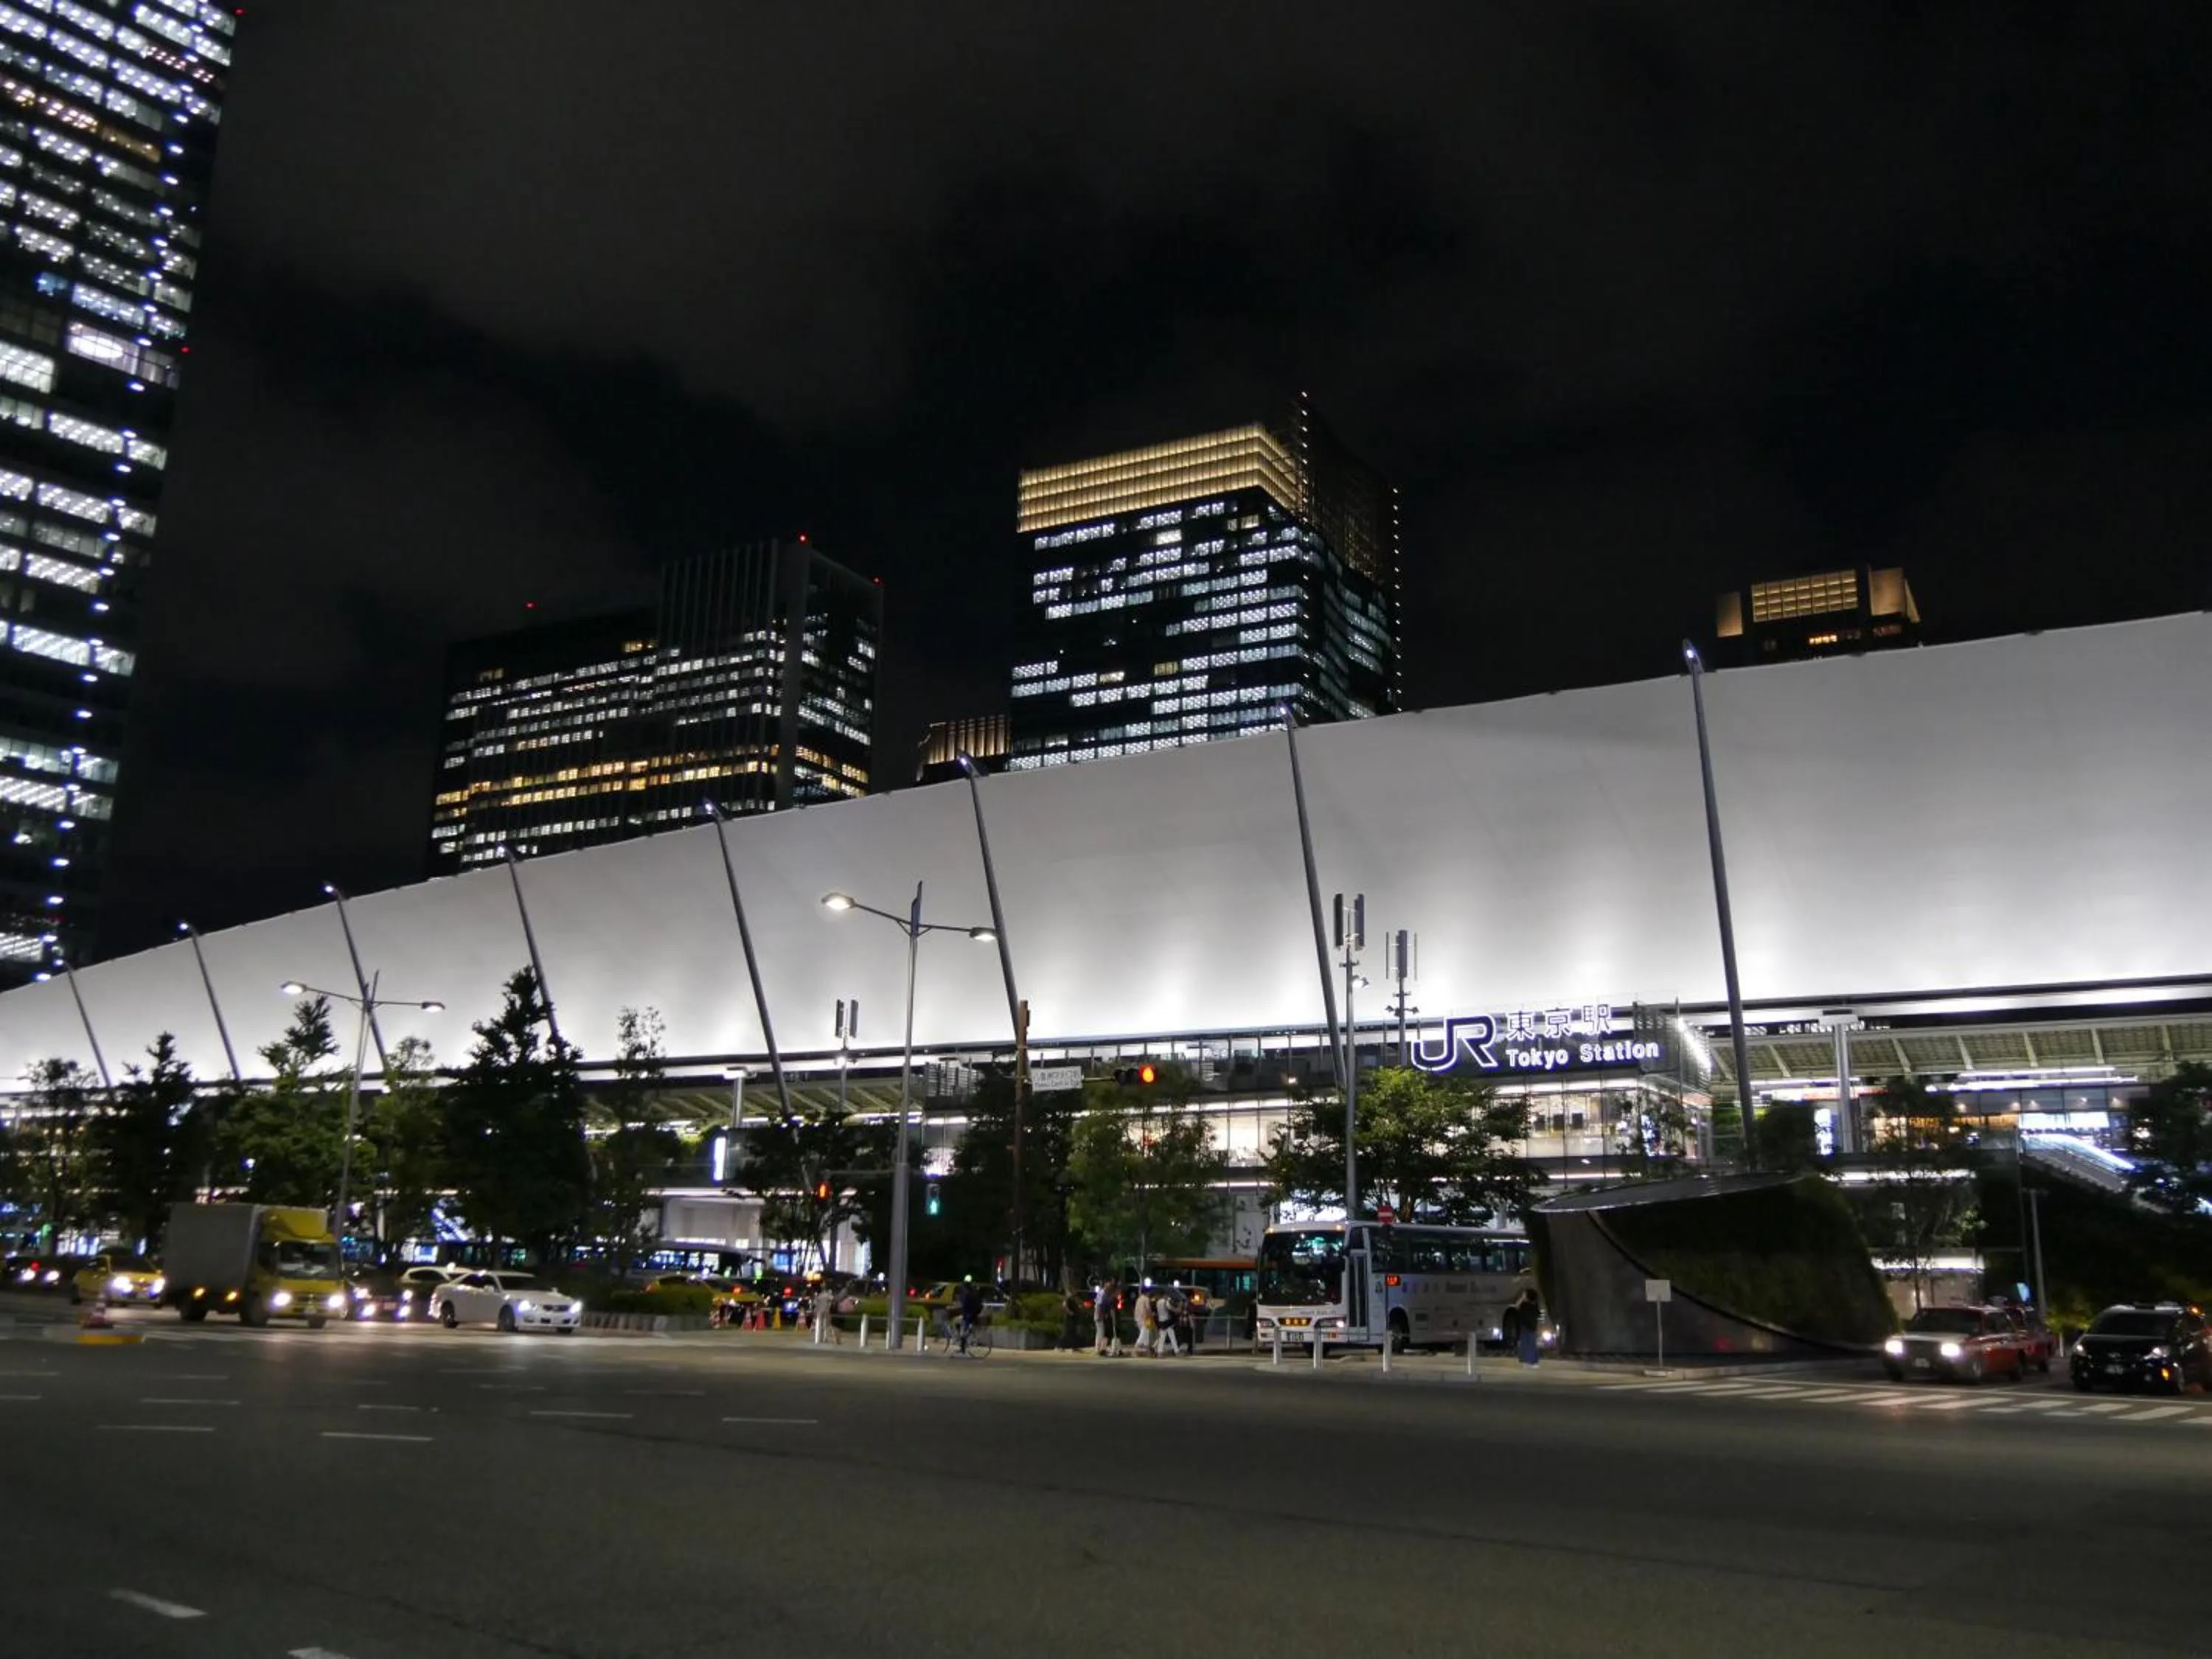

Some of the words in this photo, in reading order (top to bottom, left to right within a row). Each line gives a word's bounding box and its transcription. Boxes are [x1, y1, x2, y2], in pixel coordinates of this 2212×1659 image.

[1507, 1004, 1613, 1041] 東京駅
[1411, 1014, 1498, 1070] JR
[1506, 1048, 1568, 1069] Tokyo
[1580, 1040, 1658, 1062] Station
